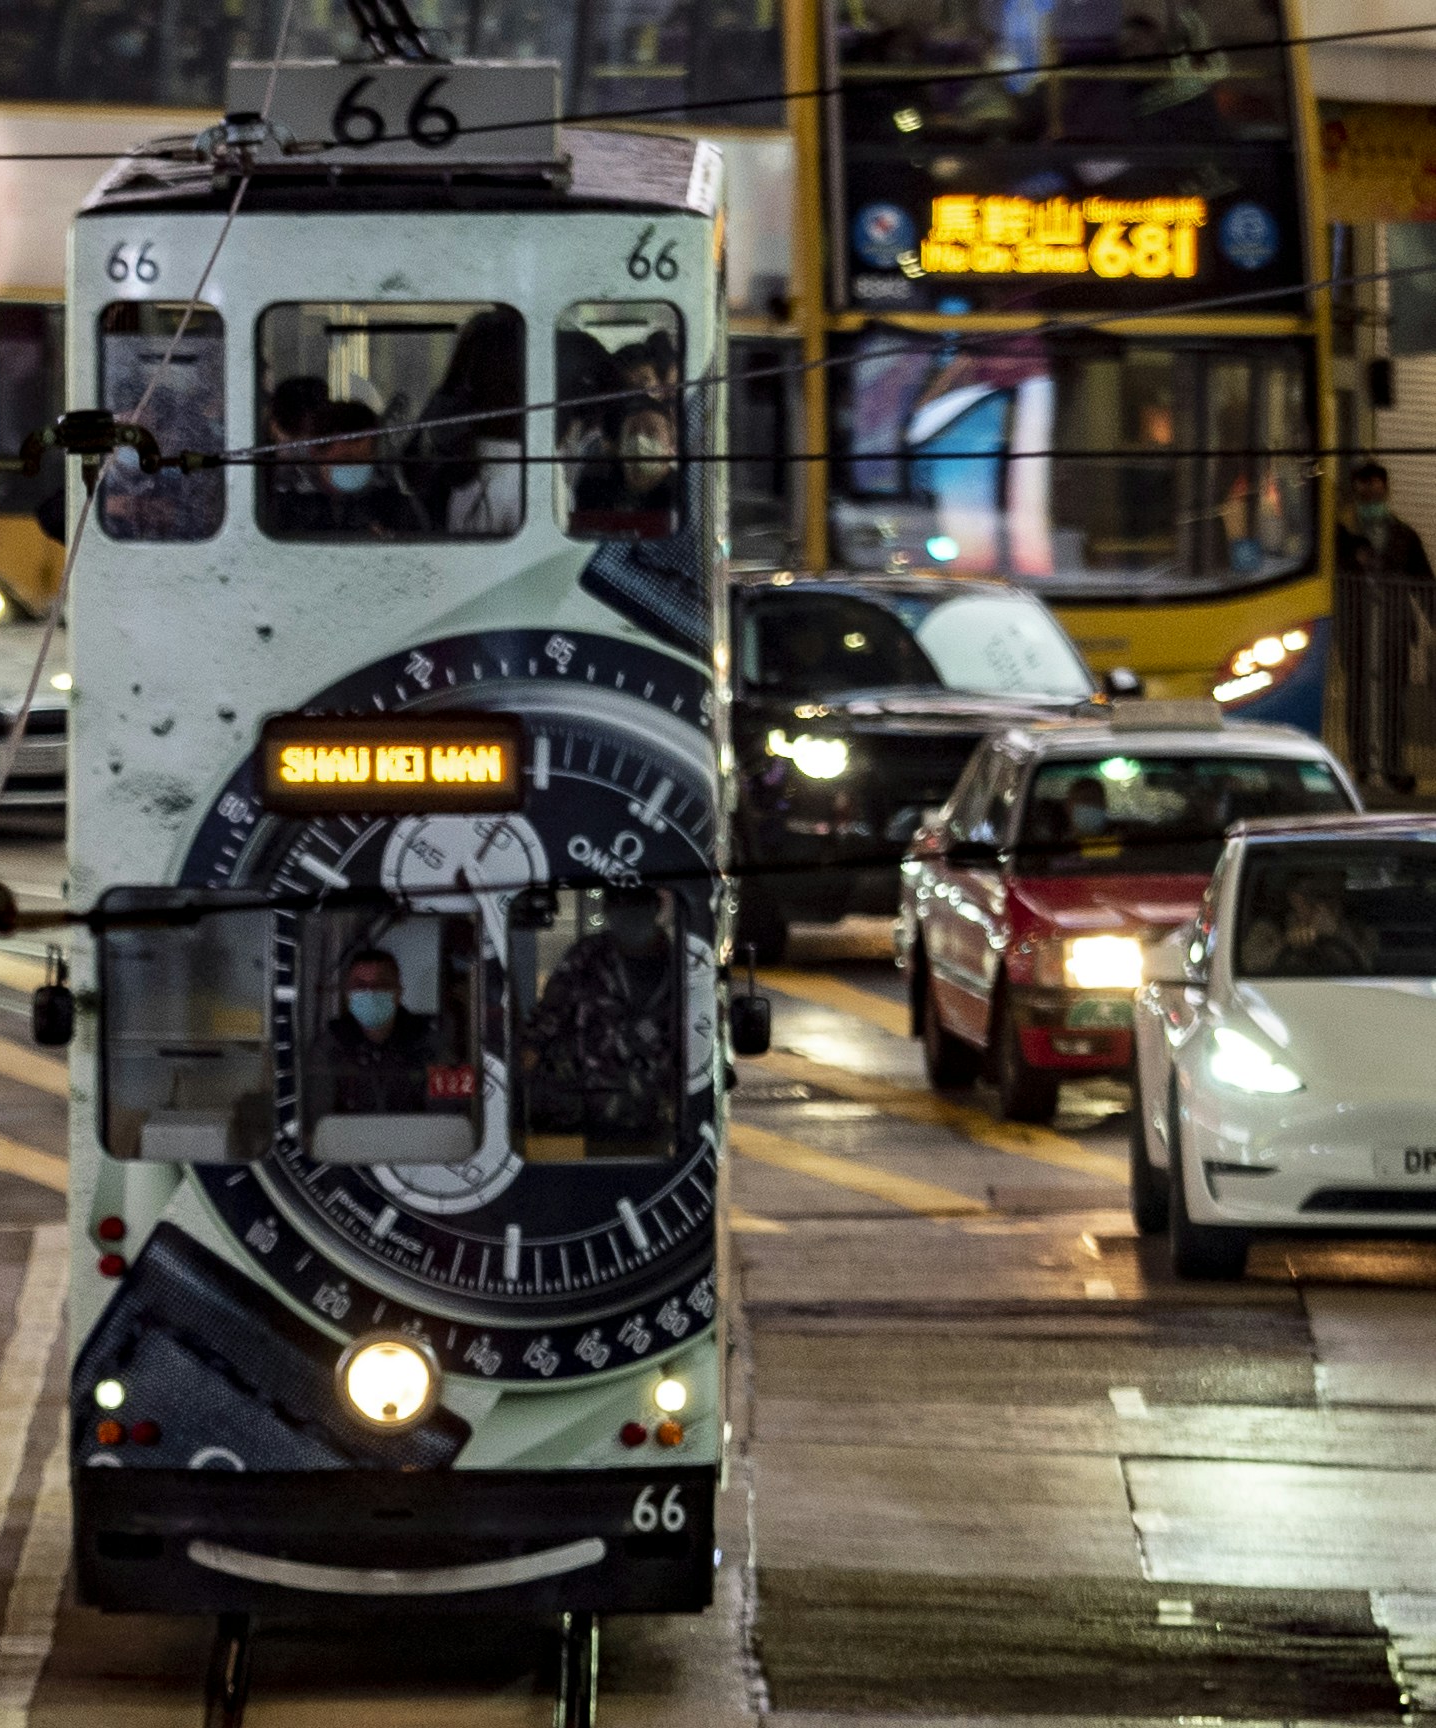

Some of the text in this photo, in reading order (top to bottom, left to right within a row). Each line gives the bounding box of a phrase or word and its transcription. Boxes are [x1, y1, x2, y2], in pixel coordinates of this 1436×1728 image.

[333, 76, 459, 149] 66
[105, 240, 160, 283] 66
[627, 236, 679, 283] 66
[1088, 222, 1198, 278] 681
[281, 746, 501, 782] SHAU KEI WAN
[633, 1485, 684, 1532] 66
